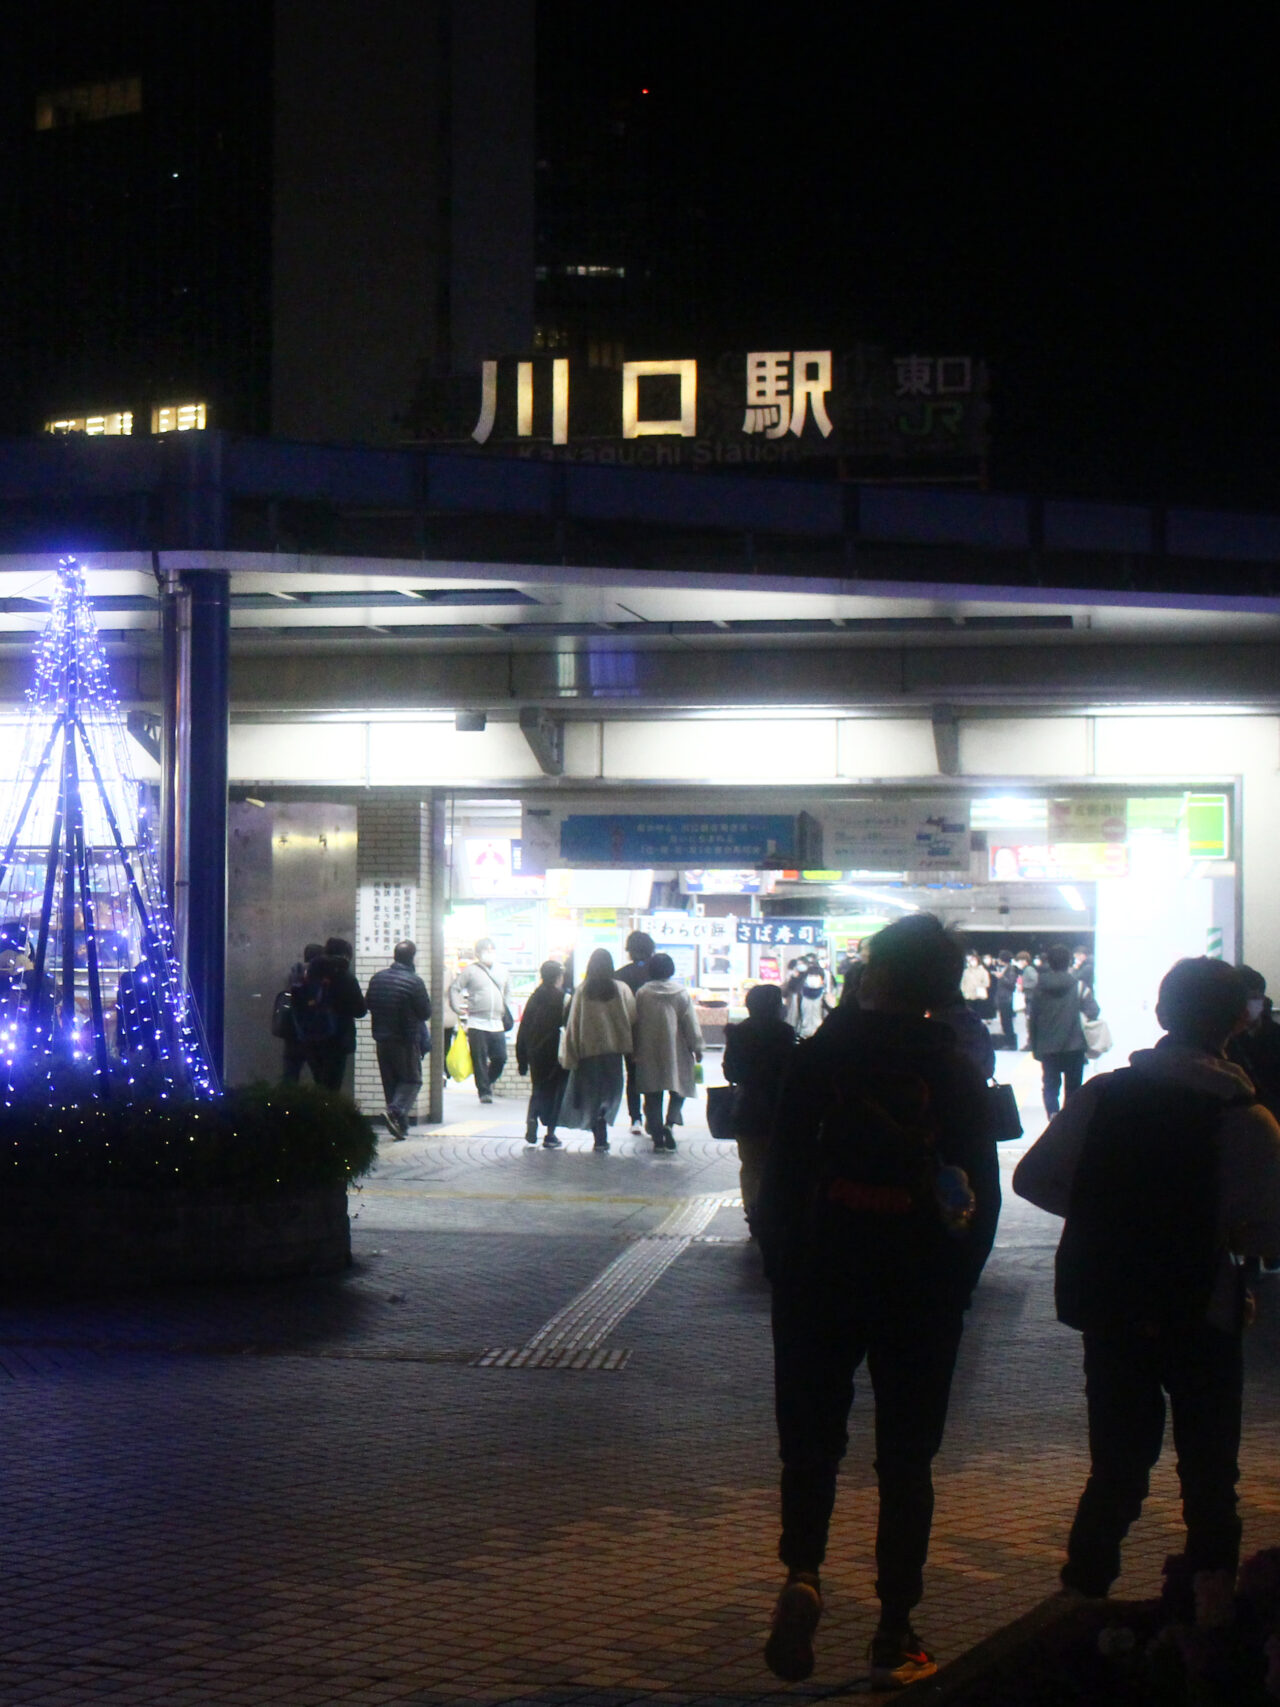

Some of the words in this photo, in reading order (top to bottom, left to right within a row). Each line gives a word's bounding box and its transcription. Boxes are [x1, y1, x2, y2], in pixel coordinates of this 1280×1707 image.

[895, 357, 971, 396] 東口
[472, 350, 832, 445] 川口駅
[900, 402, 963, 435] JR
[692, 438, 801, 465] Station
[738, 925, 814, 943] さば寿司
